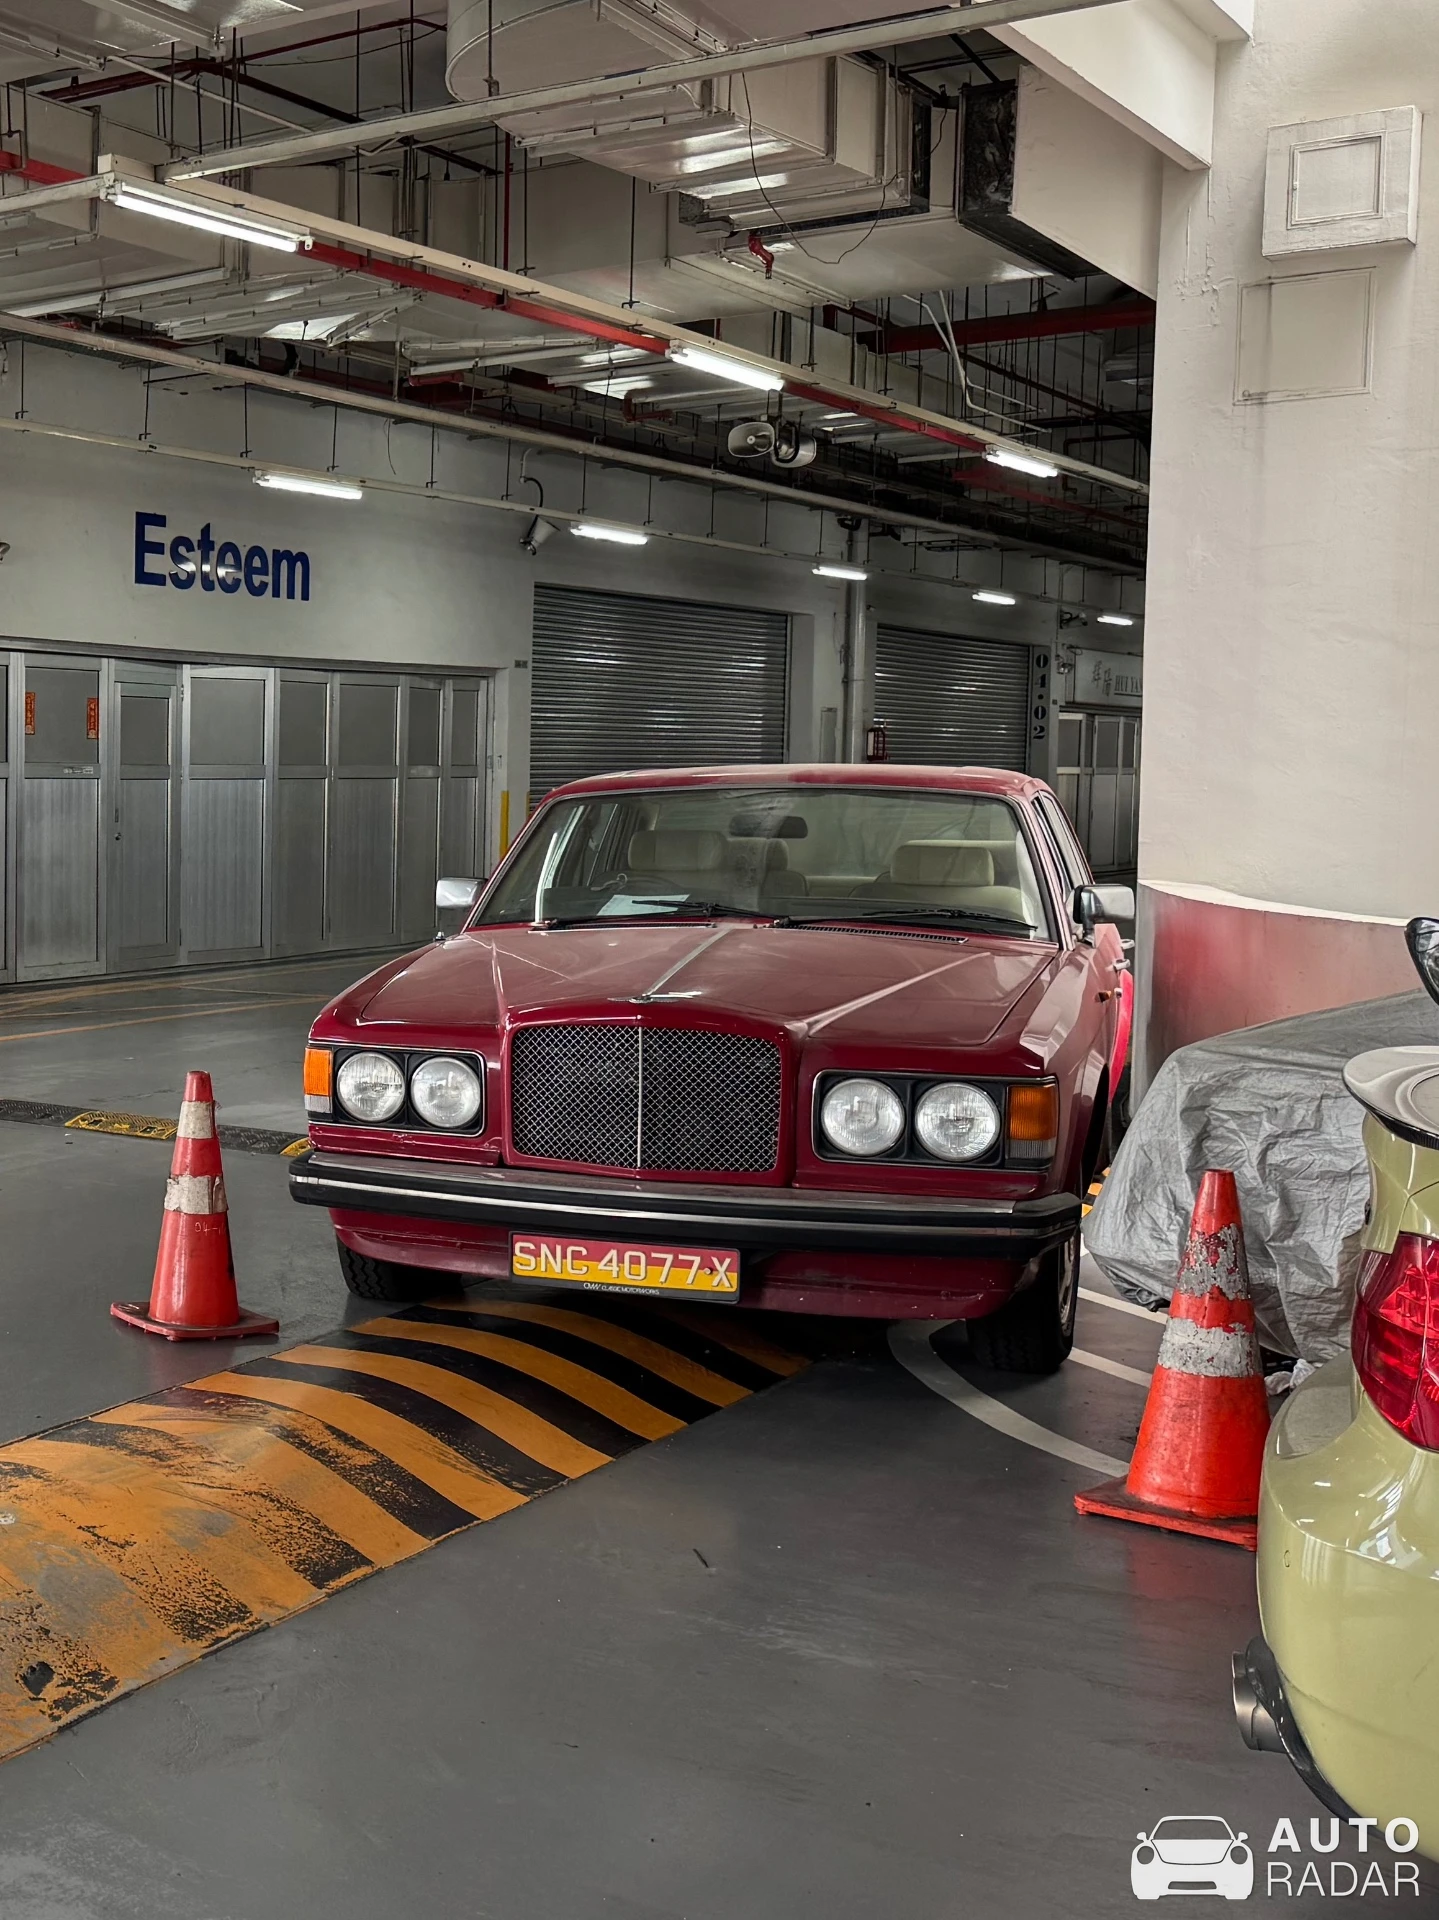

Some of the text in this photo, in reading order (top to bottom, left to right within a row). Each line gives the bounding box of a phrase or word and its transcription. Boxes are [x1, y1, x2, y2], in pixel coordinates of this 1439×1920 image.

[134, 511, 311, 602] Esteem
[514, 1241, 589, 1275] SNC
[597, 1248, 701, 1286] 4077
